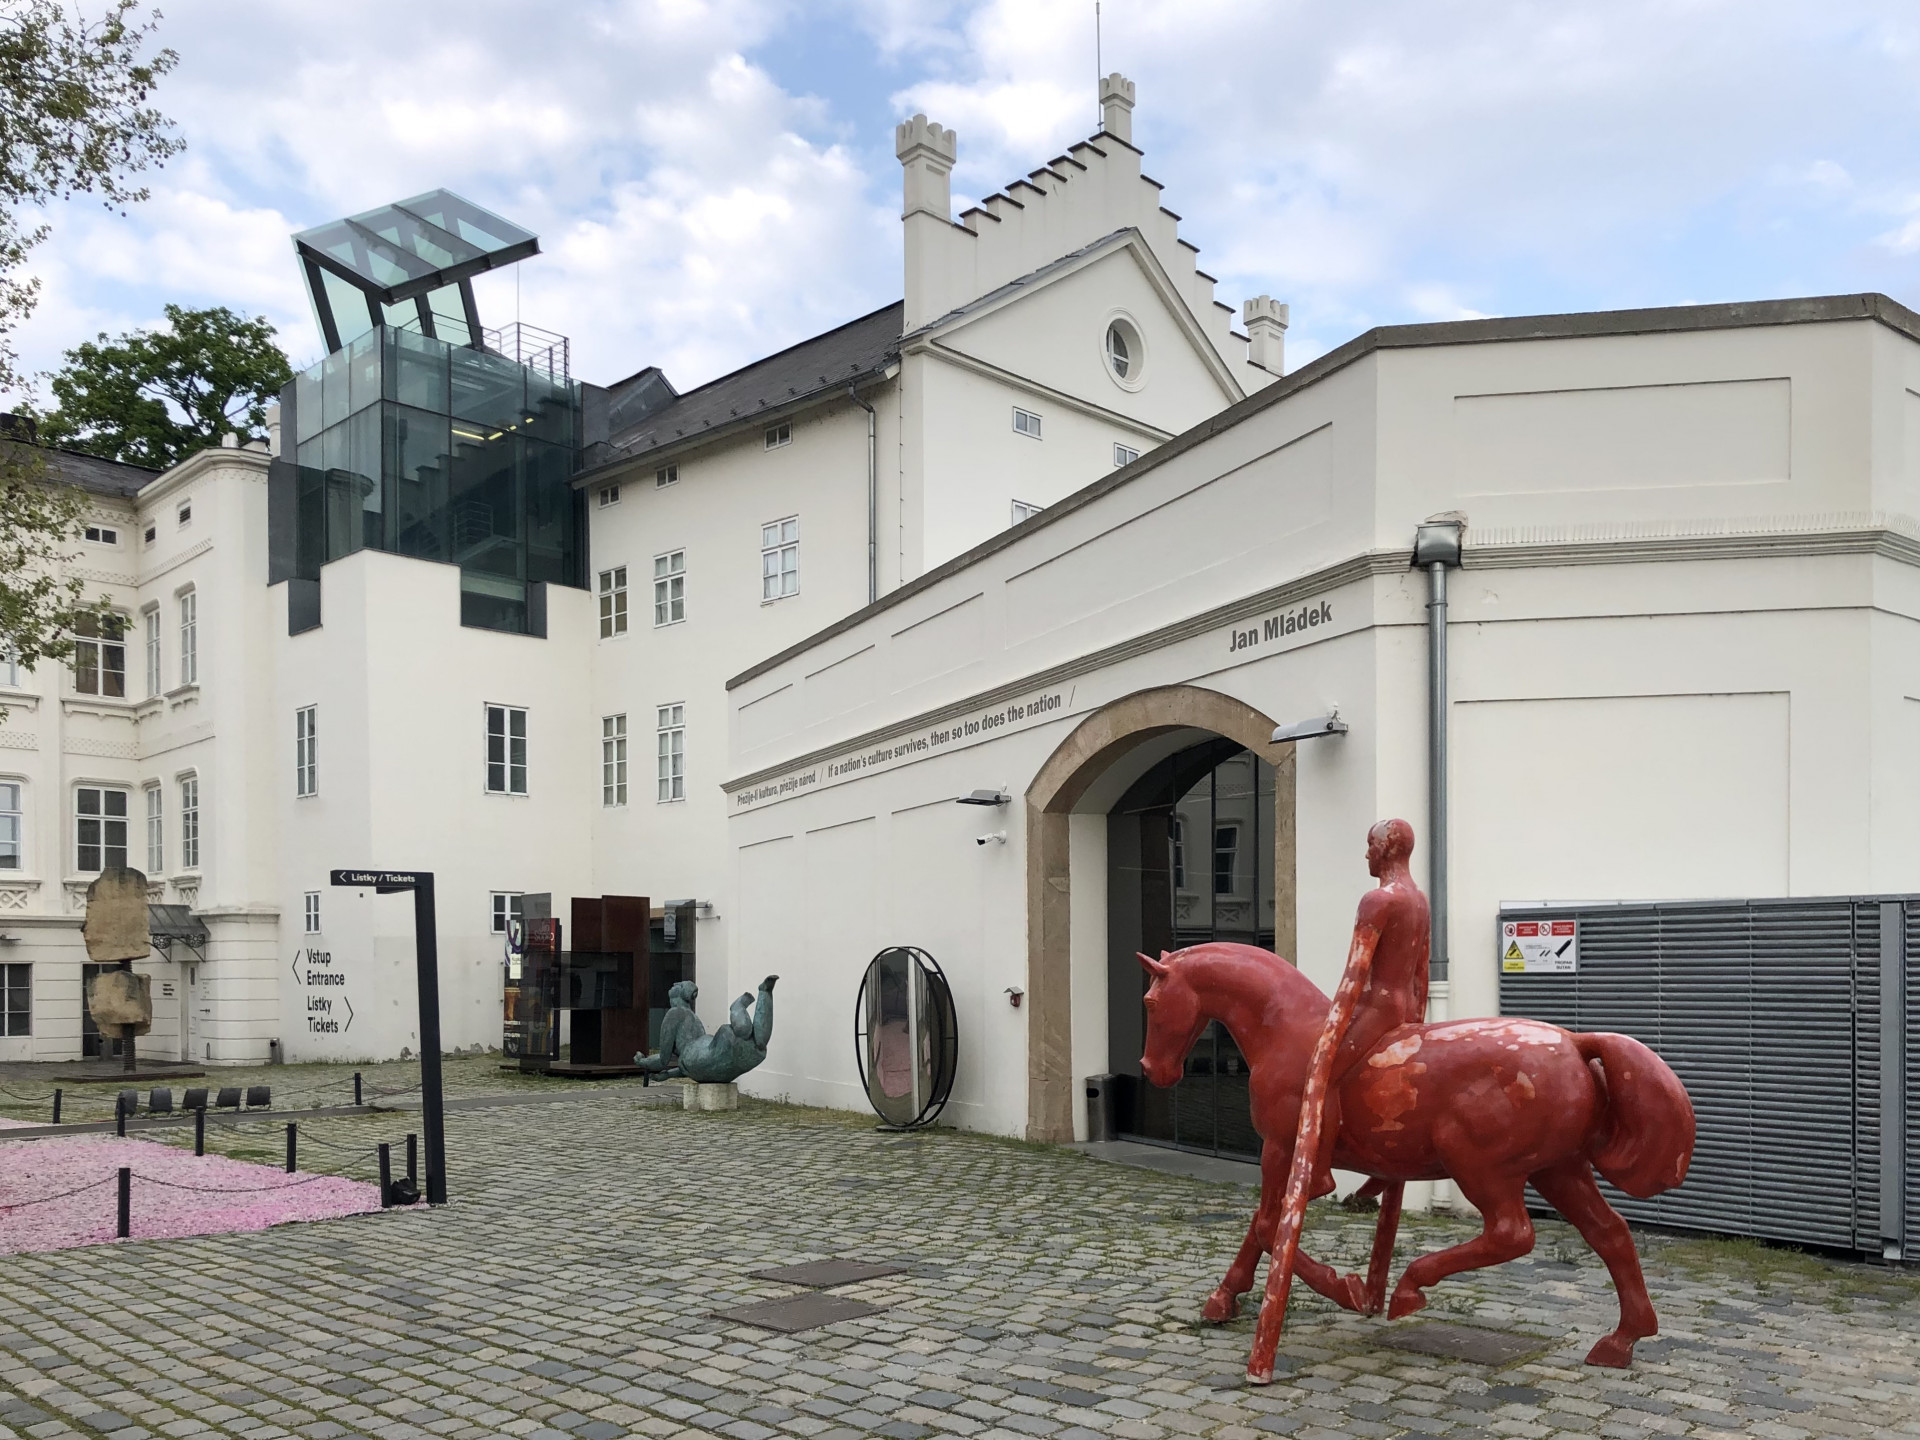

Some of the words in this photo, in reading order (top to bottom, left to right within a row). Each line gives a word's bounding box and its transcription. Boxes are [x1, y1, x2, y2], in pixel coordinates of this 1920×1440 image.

[759, 785, 778, 800] kultura,
[779, 776, 798, 795] přežije
[799, 769, 816, 787] národ
[828, 764, 834, 778] If
[834, 765, 839, 776] a
[839, 755, 866, 775] nation's
[868, 748, 893, 766] culture
[894, 737, 929, 757] survives,
[931, 731, 950, 746] then
[952, 726, 962, 740] so
[964, 720, 980, 736] too
[982, 712, 1005, 730] does
[1007, 705, 1025, 722] the
[1027, 694, 1061, 717] nation
[1229, 628, 1259, 653] Jan
[1264, 600, 1332, 641] Mládek
[351, 872, 377, 883] Lístky
[385, 873, 415, 883] Tickets
[306, 948, 331, 967] Vstup
[306, 970, 345, 986] Entrance
[307, 995, 332, 1015] Lístky
[307, 1016, 339, 1034] Tickets
